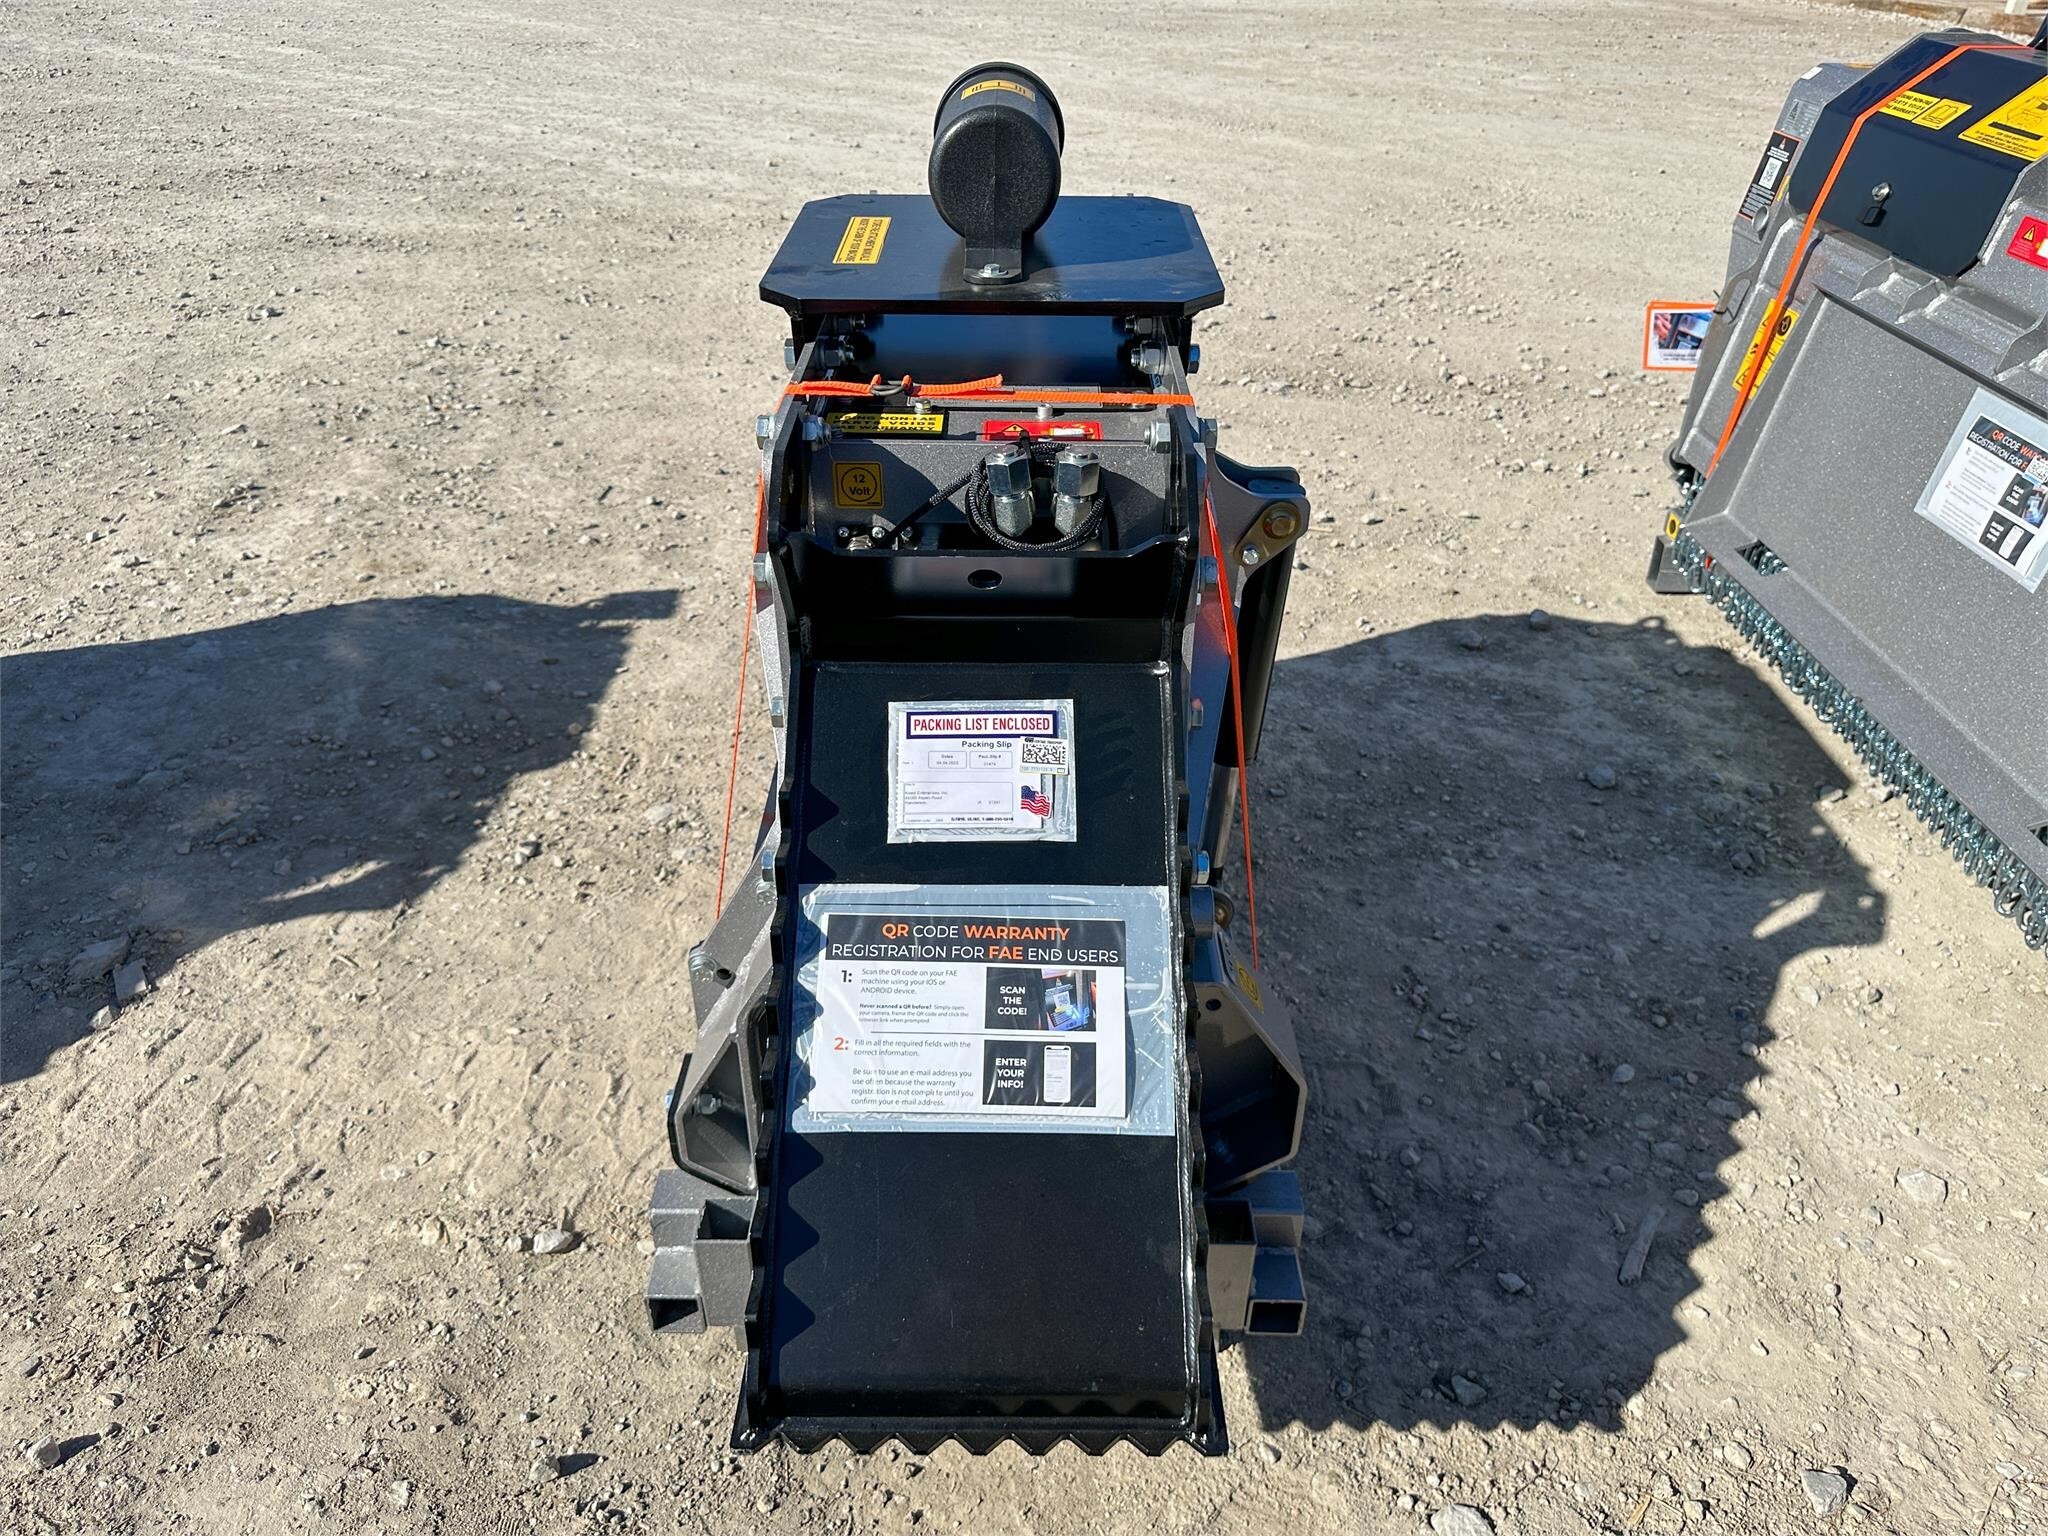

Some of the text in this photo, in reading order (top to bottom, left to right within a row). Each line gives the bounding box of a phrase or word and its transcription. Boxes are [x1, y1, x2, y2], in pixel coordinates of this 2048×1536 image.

[1992, 429, 2021, 451] QR CODE
[1969, 431, 2010, 460] REGISTRATION
[2008, 454, 2023, 468] FOR
[852, 474, 865, 484] 12
[848, 486, 871, 496] Volt
[913, 717, 1050, 732] PACKING LIST ENCLOSED
[961, 740, 1012, 749] Packing Slip
[881, 922, 1071, 941] QR CODE WARRANTY
[831, 943, 1119, 963] REGISTRATION FOR FAE END USERS
[841, 969, 853, 983] 1:
[861, 968, 878, 976] Scan
[878, 968, 890, 976] the
[890, 969, 901, 977] QR
[928, 970, 944, 979] your
[945, 969, 958, 977] FAE
[890, 978, 909, 987] using
[893, 987, 917, 995] device.
[999, 986, 1026, 995] SCAN
[1002, 996, 1022, 1005] THE
[997, 1007, 1028, 1015] CODE!
[833, 1037, 849, 1051] 2:
[894, 1040, 924, 1049] required
[924, 1040, 943, 1048] fields
[942, 1040, 959, 1048] with
[959, 1040, 972, 1048] the
[878, 1049, 920, 1057] information.
[995, 1058, 1027, 1067] ENTER
[997, 1069, 1025, 1078] YOUR
[884, 1078, 913, 1086] because
[913, 1078, 925, 1086] the
[926, 1080, 956, 1088] warranty
[997, 1079, 1024, 1089] INFO!
[851, 1088, 890, 1097] registrtion
[944, 1089, 960, 1097] until
[917, 1099, 944, 1107] address.
